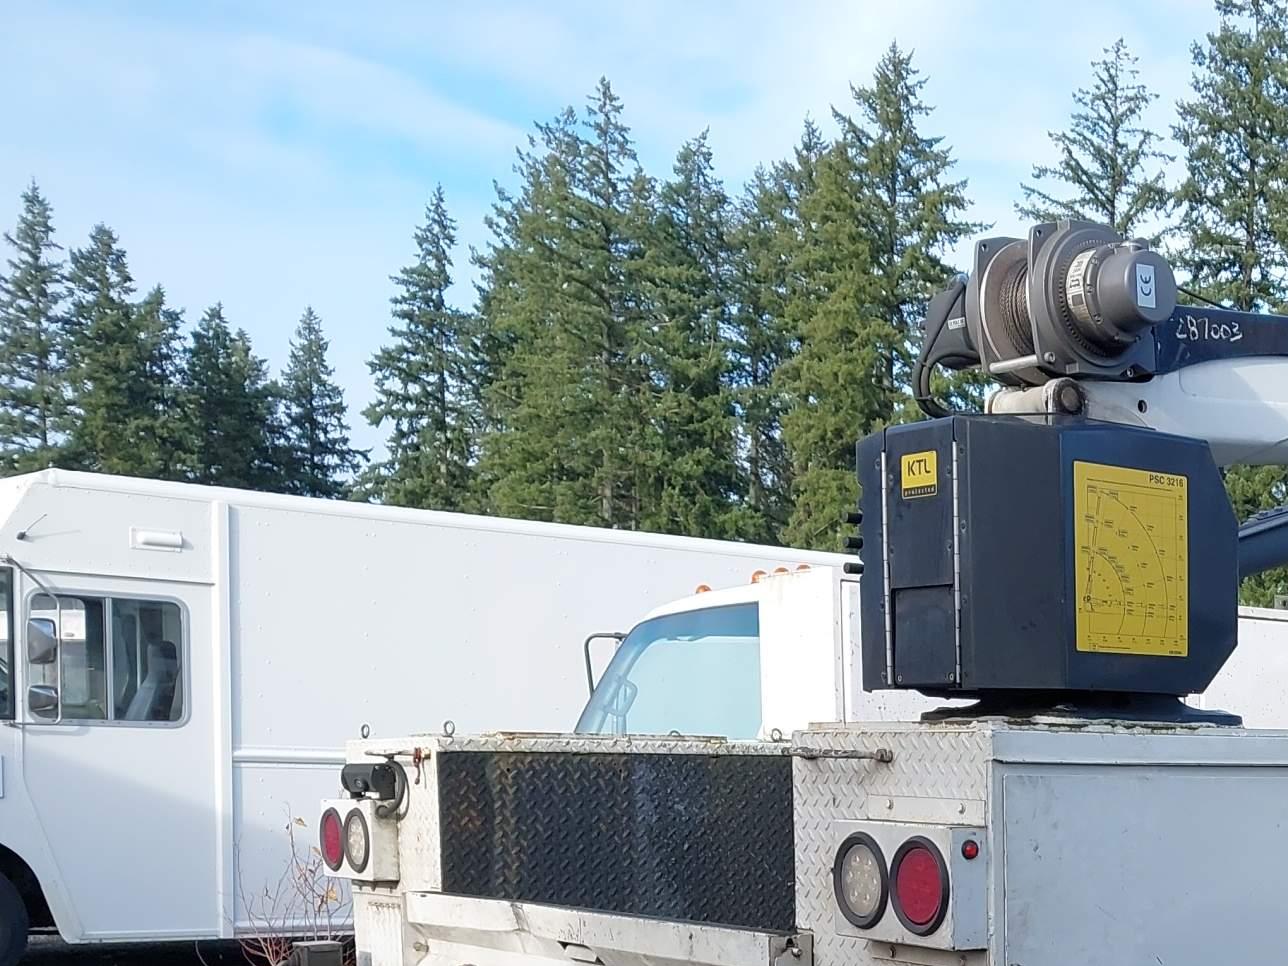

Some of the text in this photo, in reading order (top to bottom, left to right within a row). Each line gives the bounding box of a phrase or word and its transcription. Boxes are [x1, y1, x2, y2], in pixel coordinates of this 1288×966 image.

[907, 458, 931, 477] KTL
[1149, 474, 1184, 488] PSC 3216
